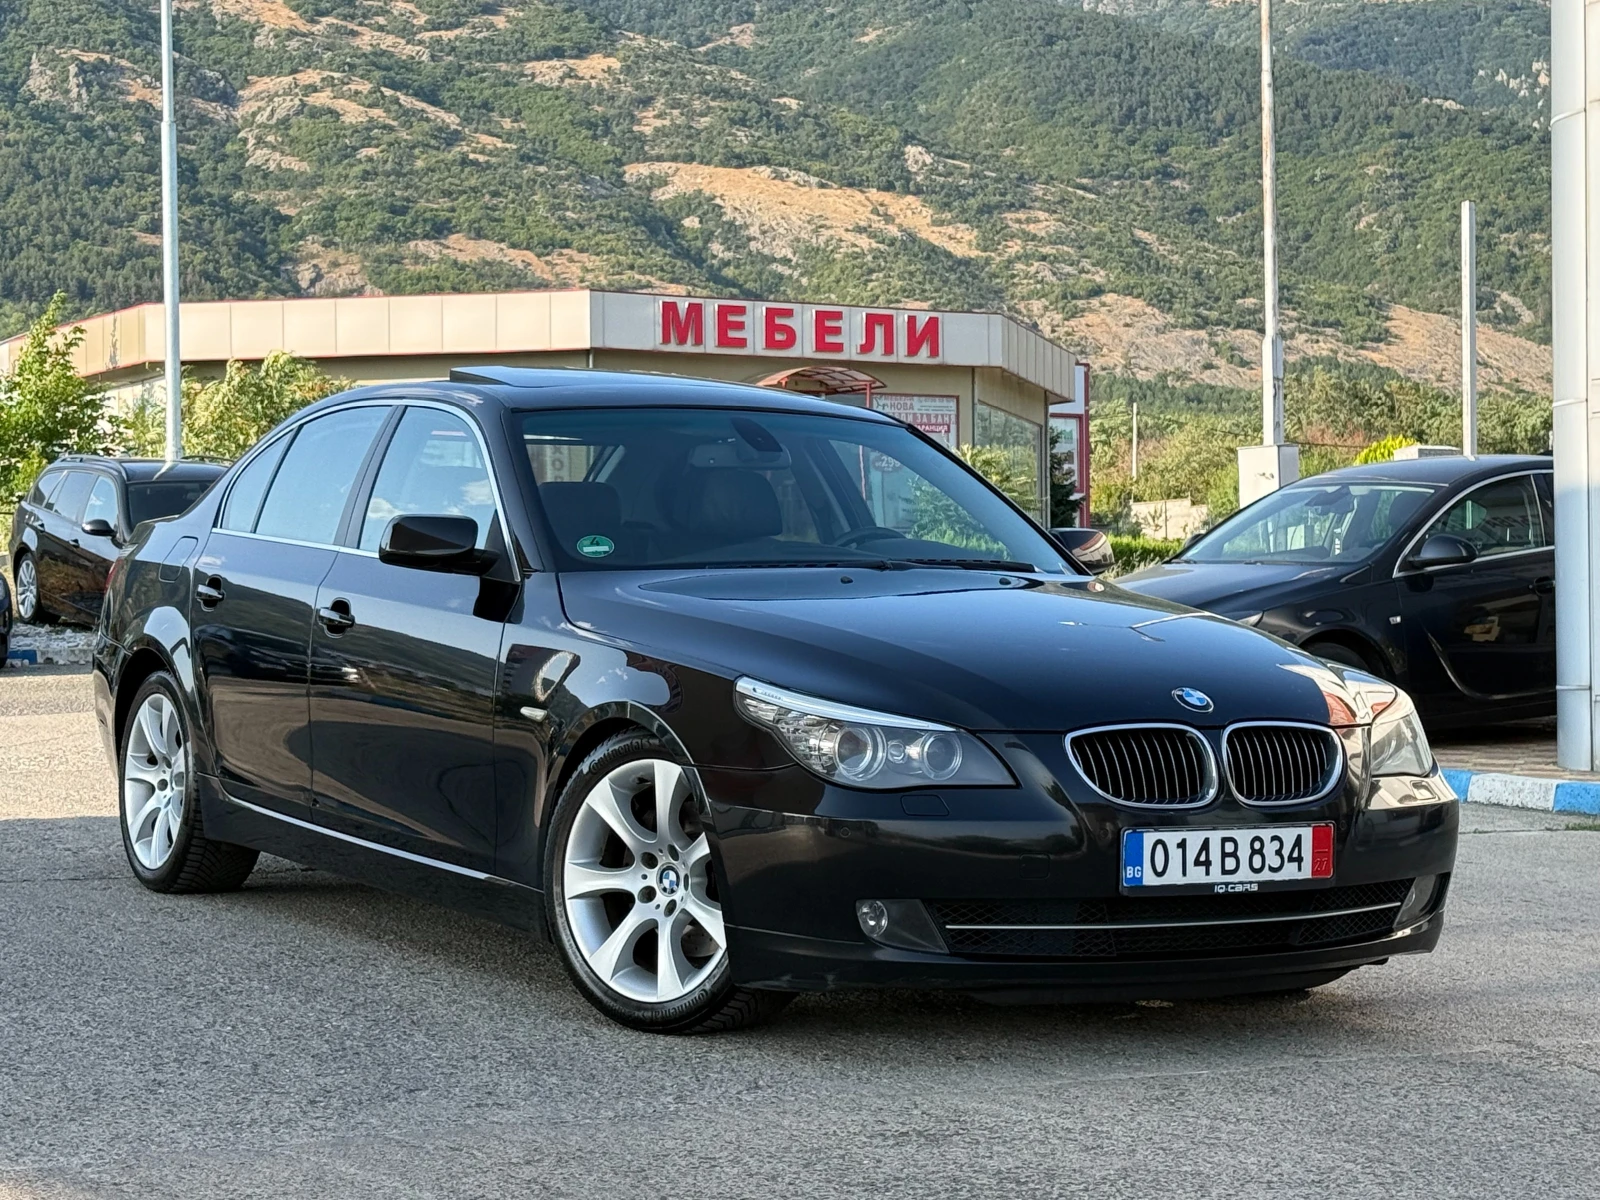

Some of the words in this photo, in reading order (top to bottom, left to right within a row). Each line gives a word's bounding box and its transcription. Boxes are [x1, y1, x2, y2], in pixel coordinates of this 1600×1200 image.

[659, 300, 940, 358] МЕБЕЛИ
[890, 402, 914, 411] НОВА
[916, 424, 948, 432] АРАНЦИЯ
[588, 739, 644, 774] Continental
[1150, 833, 1304, 878] 014B834
[1126, 866, 1142, 878] BG
